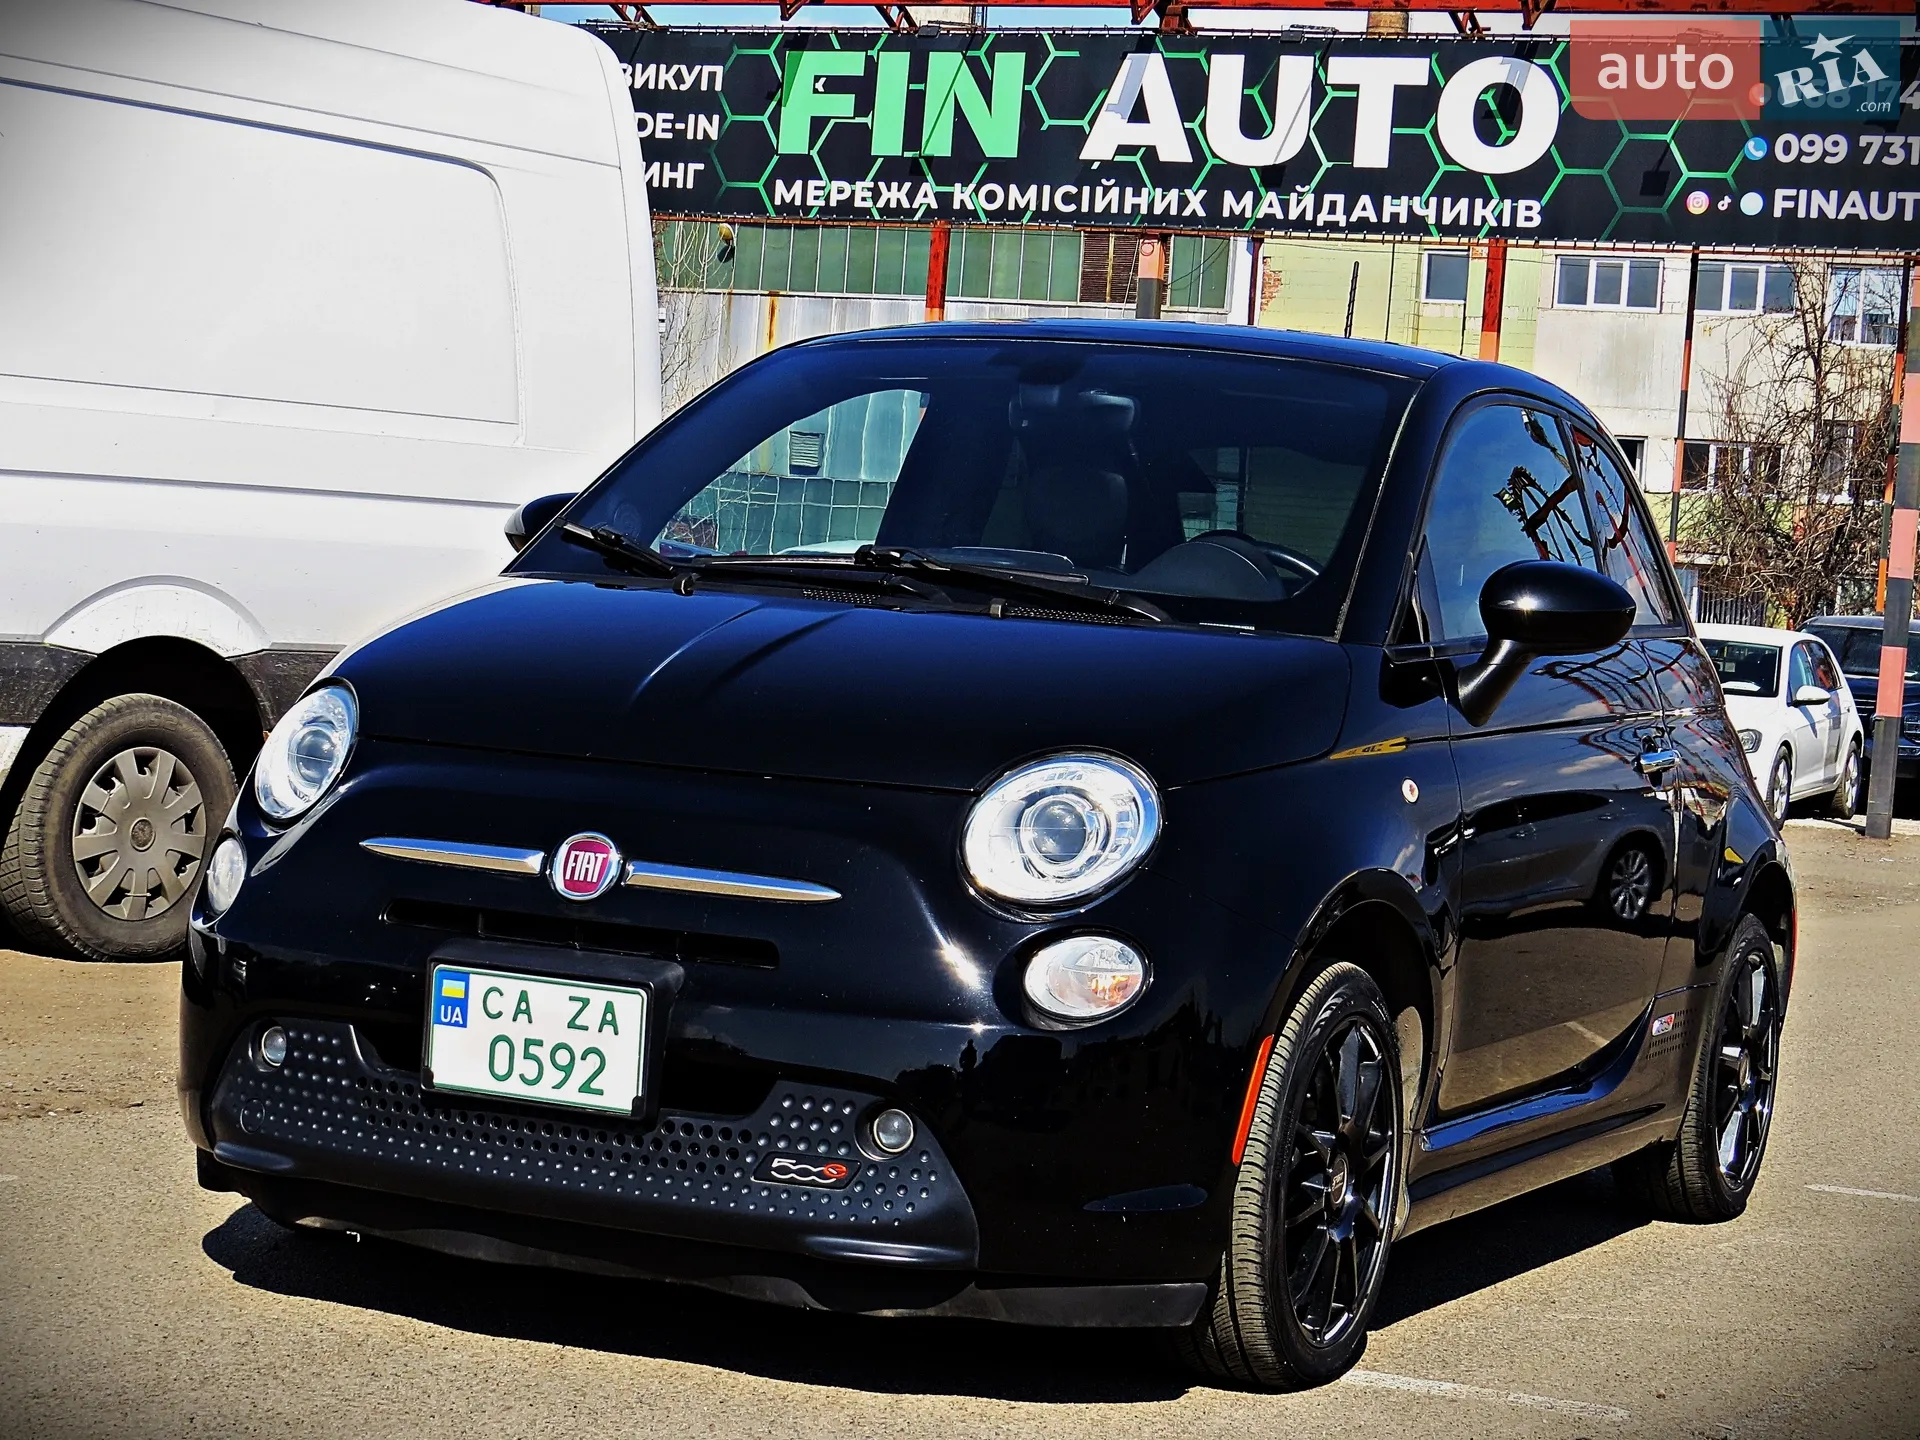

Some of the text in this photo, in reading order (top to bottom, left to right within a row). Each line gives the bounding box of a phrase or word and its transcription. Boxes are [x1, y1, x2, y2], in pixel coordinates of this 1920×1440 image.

[634, 112, 720, 140] DE-IN
[777, 51, 1562, 174] FIN AUTO
[1774, 133, 1920, 166] 099 731
[774, 178, 1542, 228] МЕРЕЖА КОМІСІЙНИХ МАЙДАНЧИКІВ
[1772, 188, 1920, 222] FINAUT
[565, 850, 608, 883] FIAT
[440, 1004, 464, 1025] UA
[482, 986, 620, 1036] CA ZA
[488, 1034, 607, 1096] 0592
